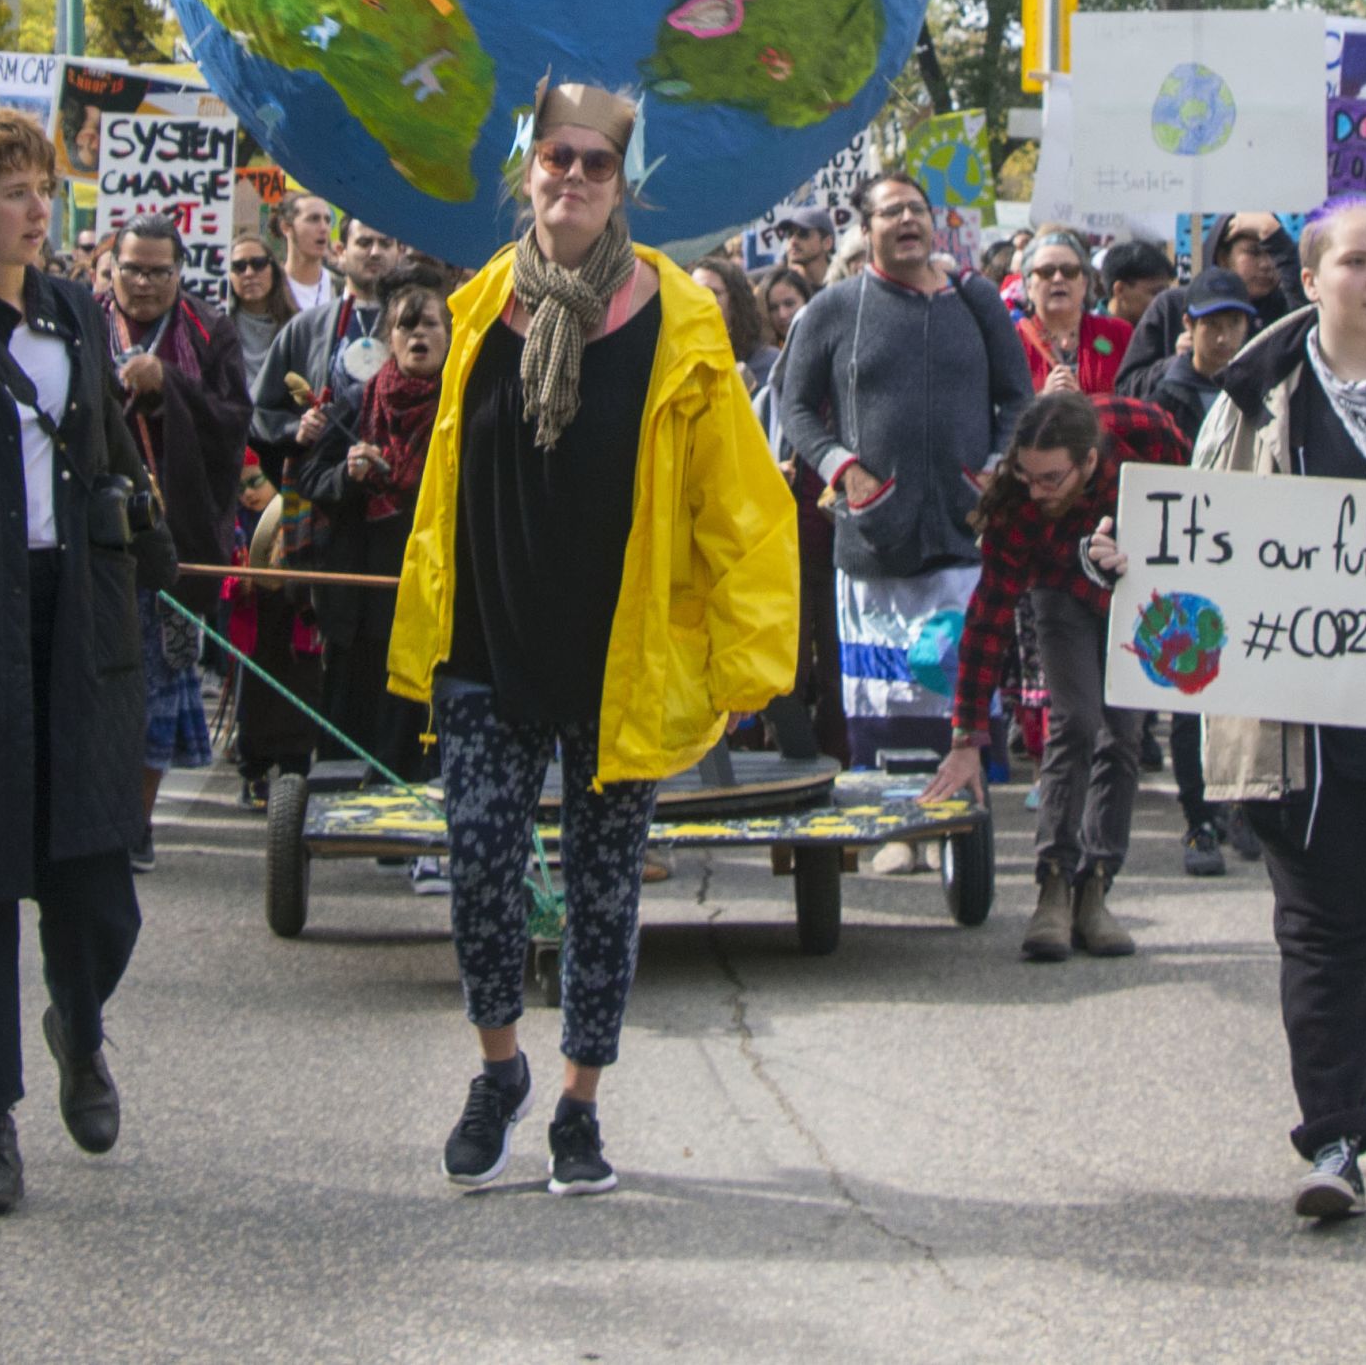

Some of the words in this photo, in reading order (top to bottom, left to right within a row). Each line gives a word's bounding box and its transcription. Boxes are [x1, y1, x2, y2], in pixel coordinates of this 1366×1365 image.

[108, 119, 235, 168] SYSTEM
[101, 169, 231, 205] CHANGE
[1145, 491, 1234, 566] It's
[1258, 538, 1321, 571] our
